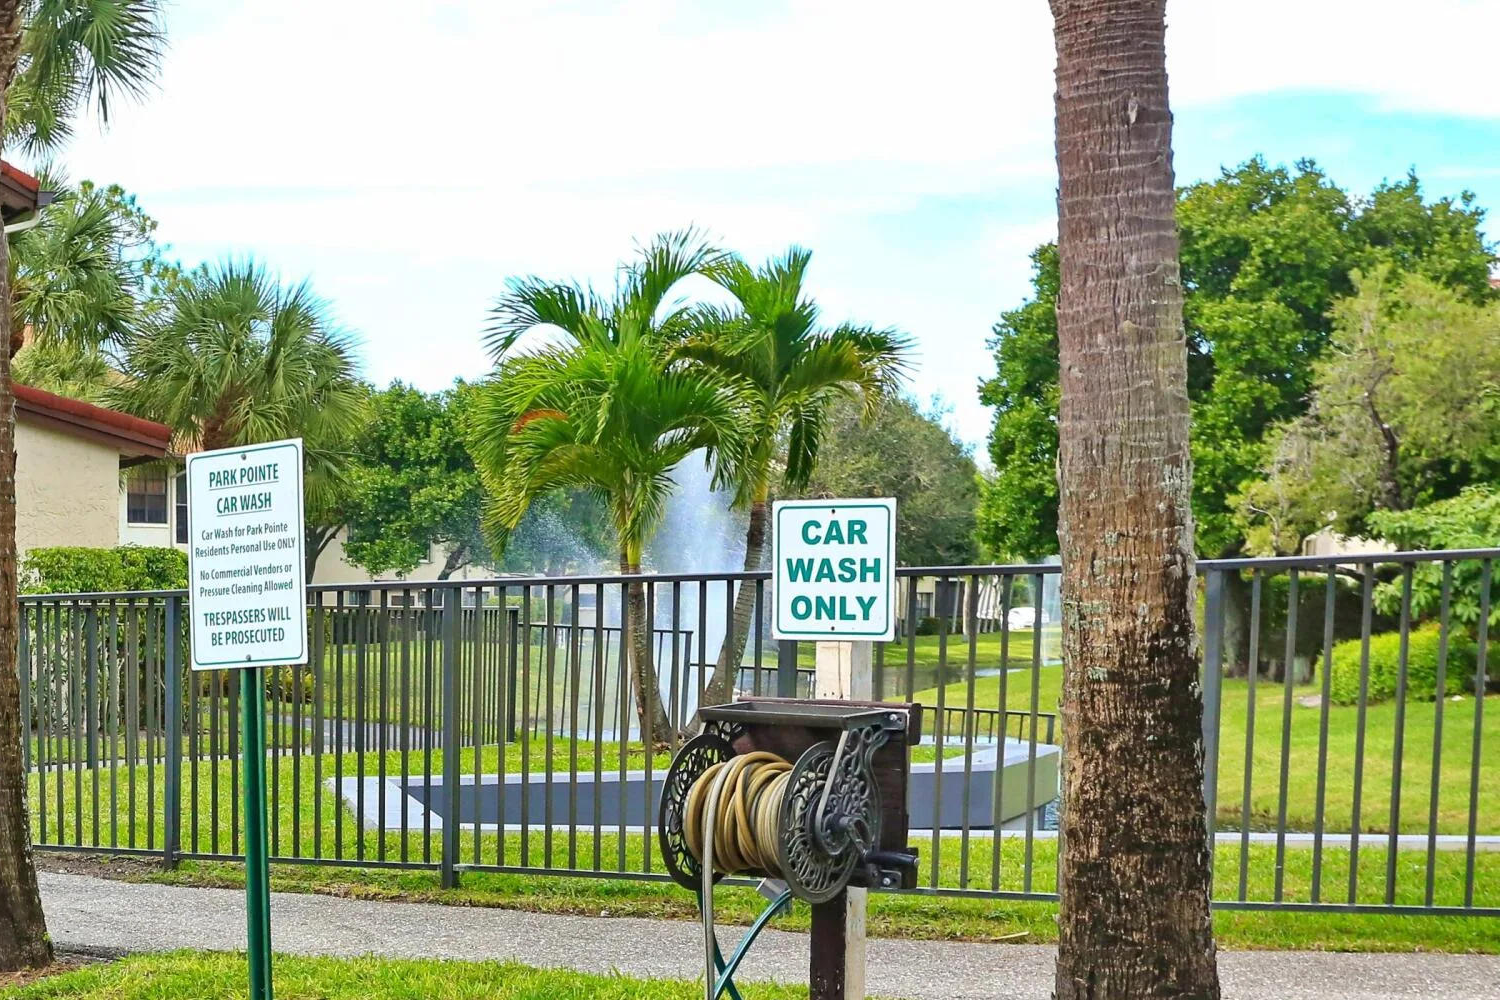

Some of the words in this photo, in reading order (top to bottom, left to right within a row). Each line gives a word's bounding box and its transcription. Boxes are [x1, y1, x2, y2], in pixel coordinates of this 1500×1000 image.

[209, 469, 237, 488] PARK
[240, 463, 279, 484] POINTE
[216, 496, 237, 514] CAR
[240, 492, 272, 511] WASH
[201, 530, 213, 541] Car
[214, 526, 233, 539] Wash
[234, 525, 245, 537] for
[246, 524, 263, 535] Park
[264, 522, 288, 534] Pointe
[801, 520, 868, 545] CAR
[195, 544, 229, 558] Residents
[230, 541, 262, 554] Personal
[263, 540, 276, 551] Use
[277, 537, 296, 550] ONLY
[200, 570, 210, 581] No
[211, 565, 253, 580] Commercial
[253, 563, 283, 576] Vendors
[284, 564, 292, 573] or
[786, 558, 881, 583] WASH
[200, 586, 230, 598] Pressure
[231, 582, 263, 595] Cleaning
[264, 578, 293, 592] Allowed
[203, 608, 266, 627] TRESPASSERS
[267, 606, 292, 622] WILL
[790, 595, 878, 620] ONLY
[211, 632, 223, 647] BE
[225, 627, 285, 646] PROSECUTED
